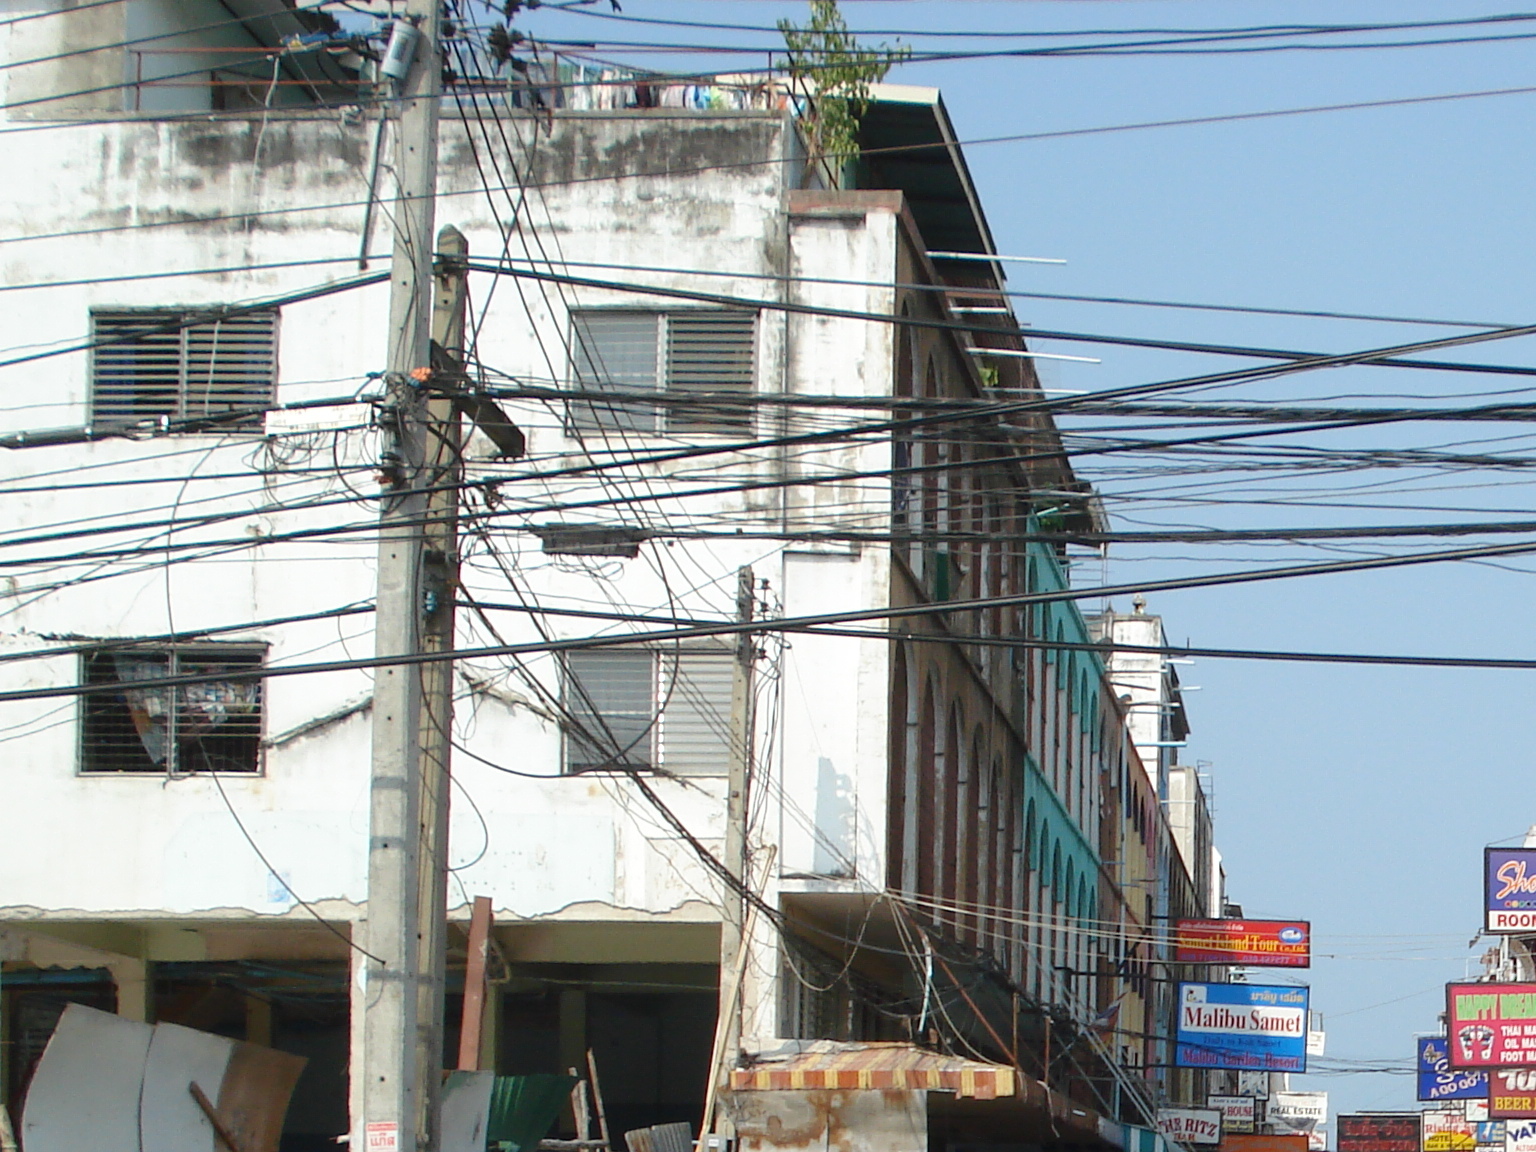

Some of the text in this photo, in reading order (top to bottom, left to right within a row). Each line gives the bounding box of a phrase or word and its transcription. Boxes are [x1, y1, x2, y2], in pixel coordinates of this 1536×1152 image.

[1250, 934, 1279, 952] Tour
[1455, 994, 1498, 1020] HAPPY
[1184, 1007, 1301, 1033] Malibu Samet
[1500, 1025, 1522, 1036] THAI
[1504, 1038, 1519, 1049] OIL
[1501, 1052, 1523, 1062] FOOT
[1494, 1097, 1531, 1111] BEER
[1270, 1107, 1322, 1116] REAL ESTATE
[1158, 1117, 1181, 1134] THE
[1184, 1117, 1219, 1138] RITZ
